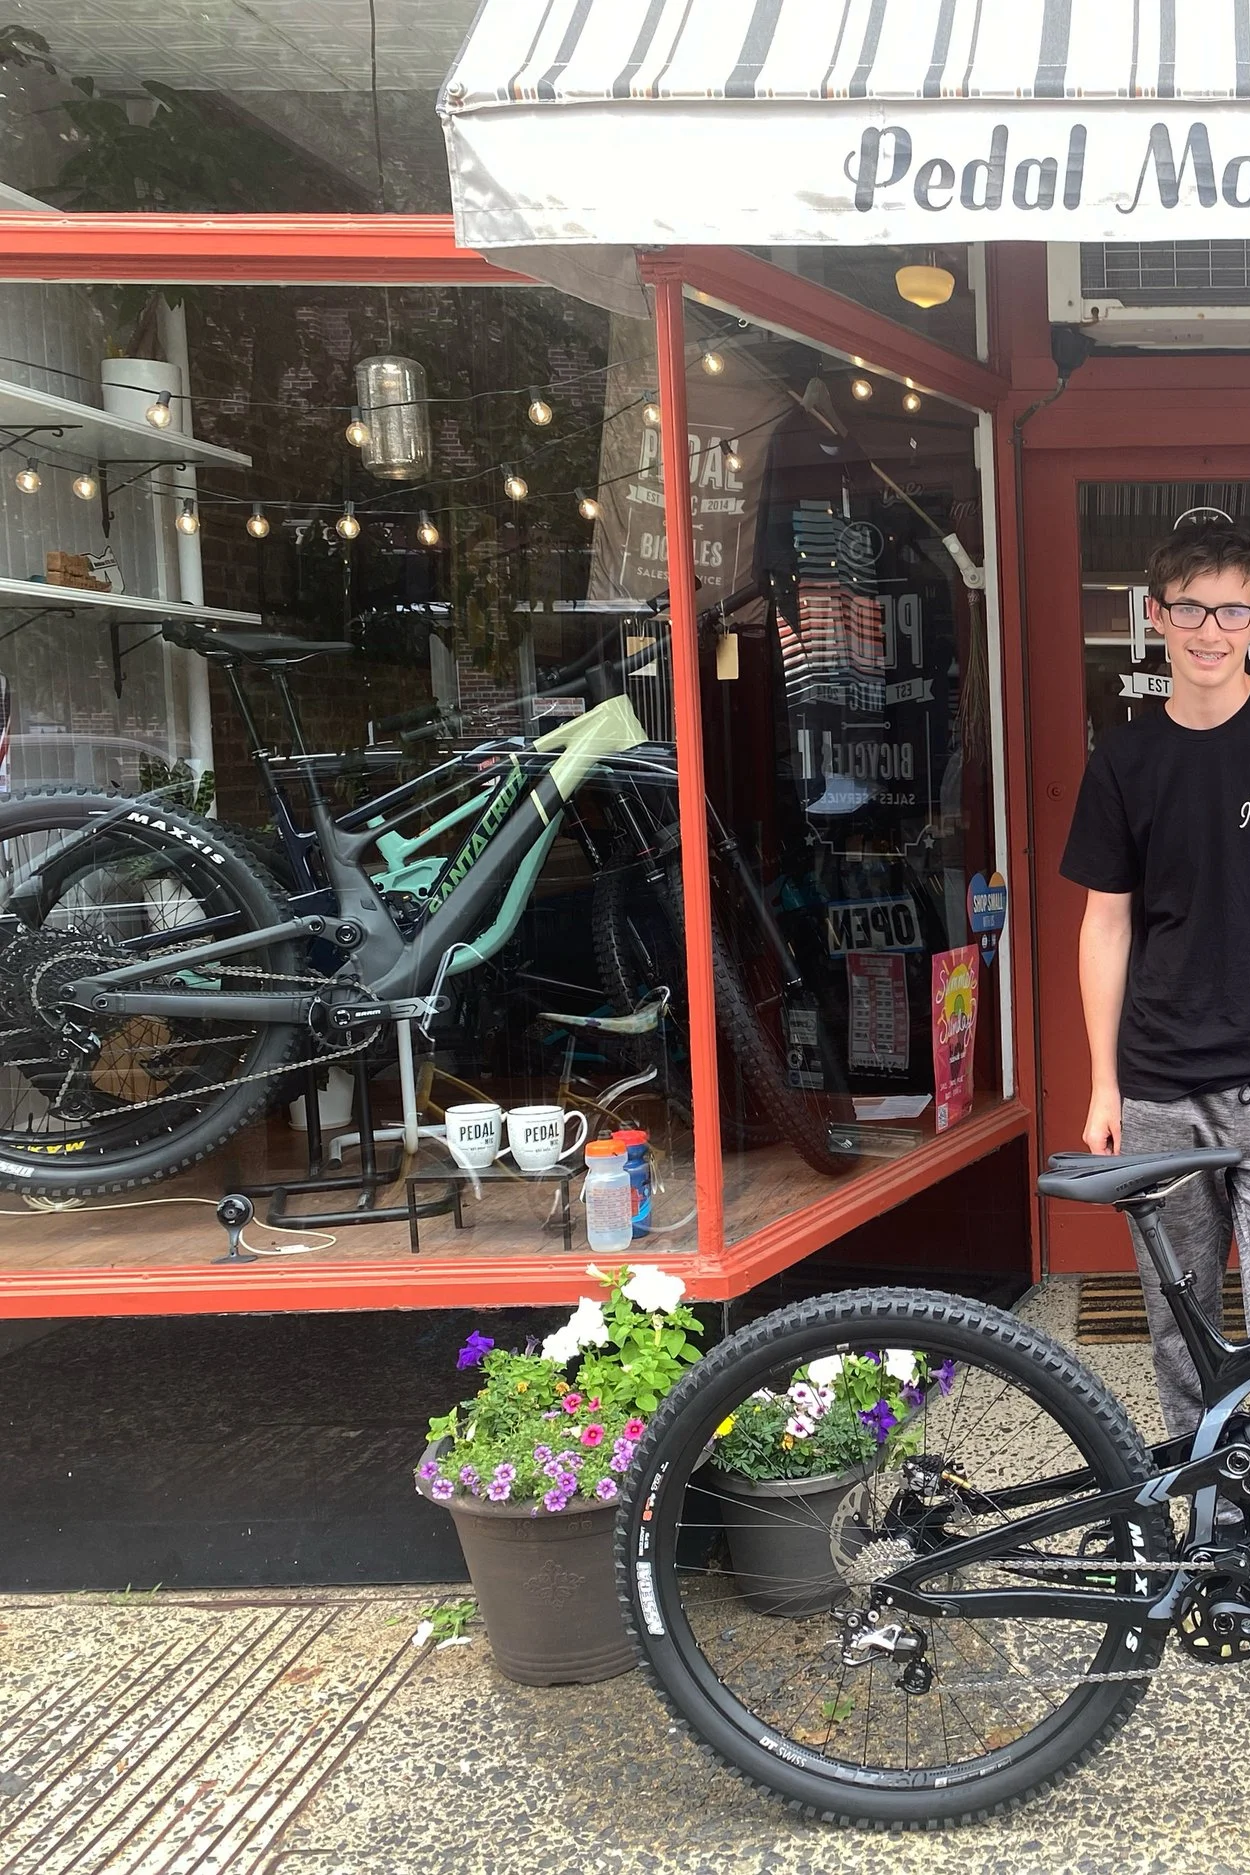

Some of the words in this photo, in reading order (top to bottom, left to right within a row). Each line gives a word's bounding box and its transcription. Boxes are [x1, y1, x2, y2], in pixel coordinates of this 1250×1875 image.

[843, 122, 1088, 213] Pedal
[637, 428, 744, 492] PDAL
[707, 501, 730, 512] 2014
[1147, 677, 1171, 694] EST
[126, 811, 227, 865] MAXXIS
[428, 831, 489, 915] SANTA
[481, 770, 529, 838] CRUZ
[973, 894, 988, 914] SHOP
[987, 892, 1004, 912] SMALL
[459, 1120, 496, 1142] PEDAL
[524, 1121, 560, 1145] PEDAL
[758, 1734, 779, 1751] DT
[775, 1746, 809, 1769] SWISS
